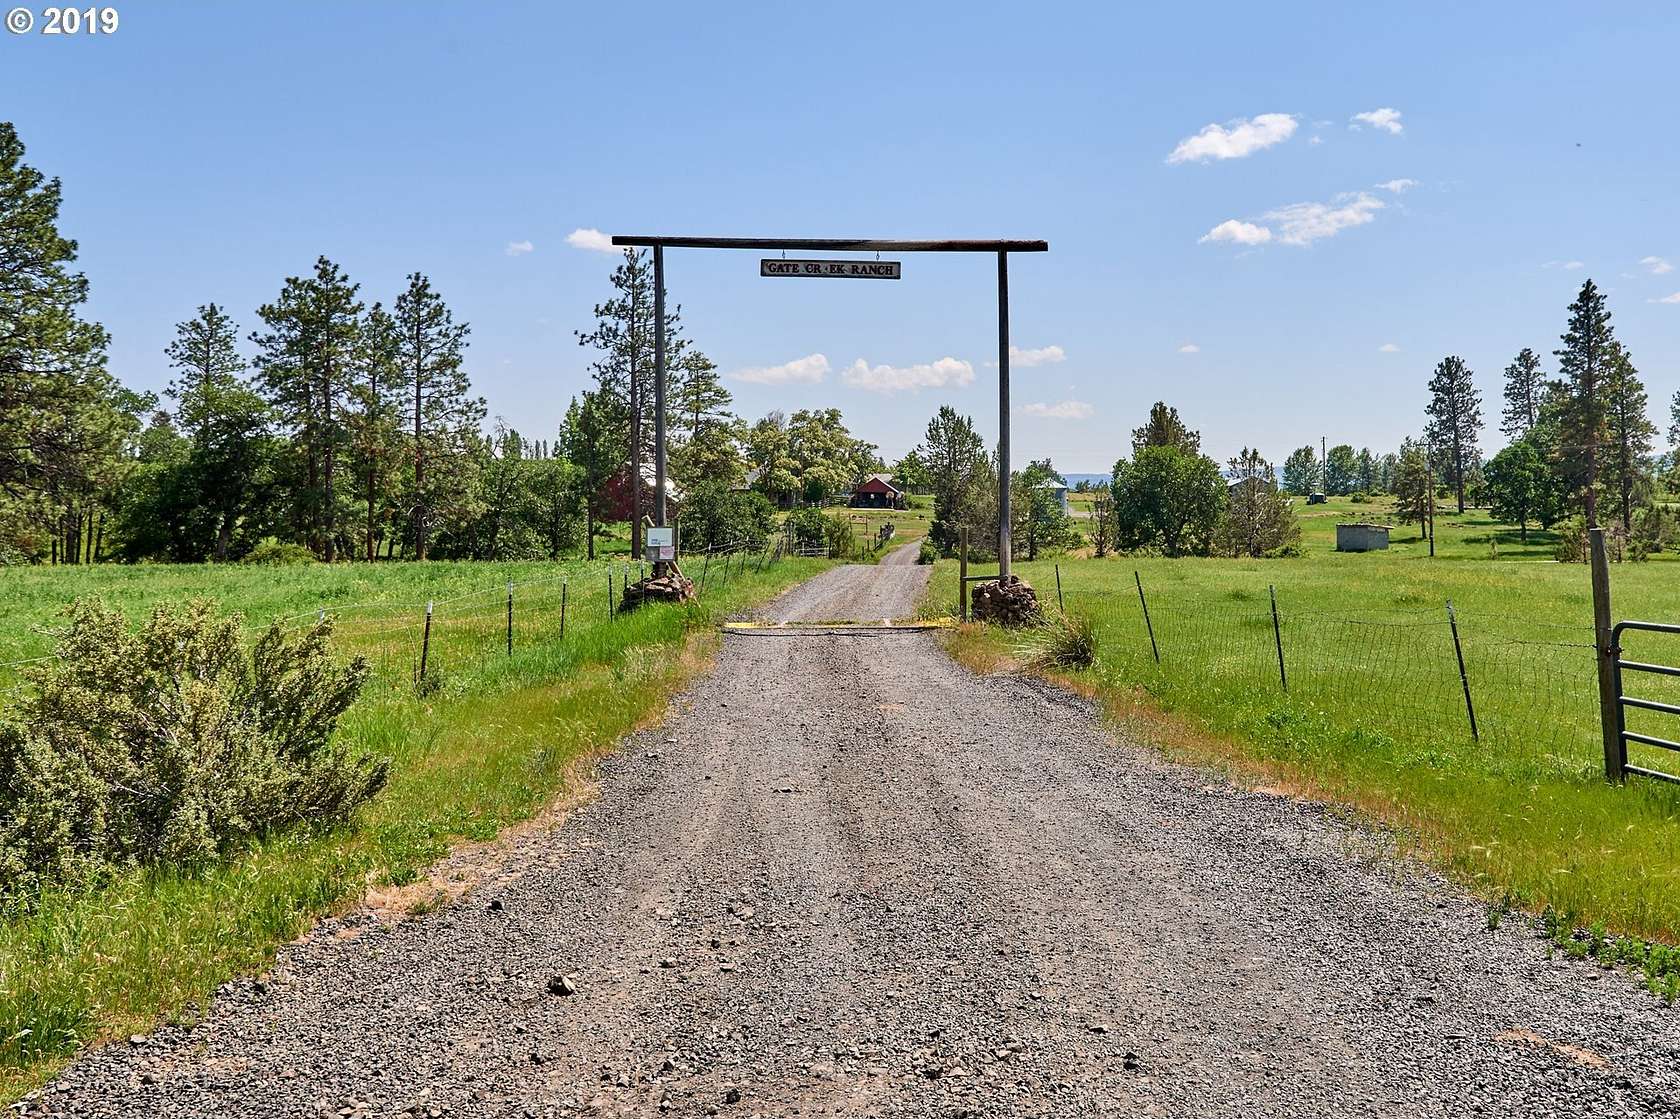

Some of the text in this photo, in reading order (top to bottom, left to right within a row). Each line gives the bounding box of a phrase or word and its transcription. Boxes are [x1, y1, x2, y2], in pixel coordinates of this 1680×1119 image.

[767, 262, 894, 276] GATE CREK RANCH
